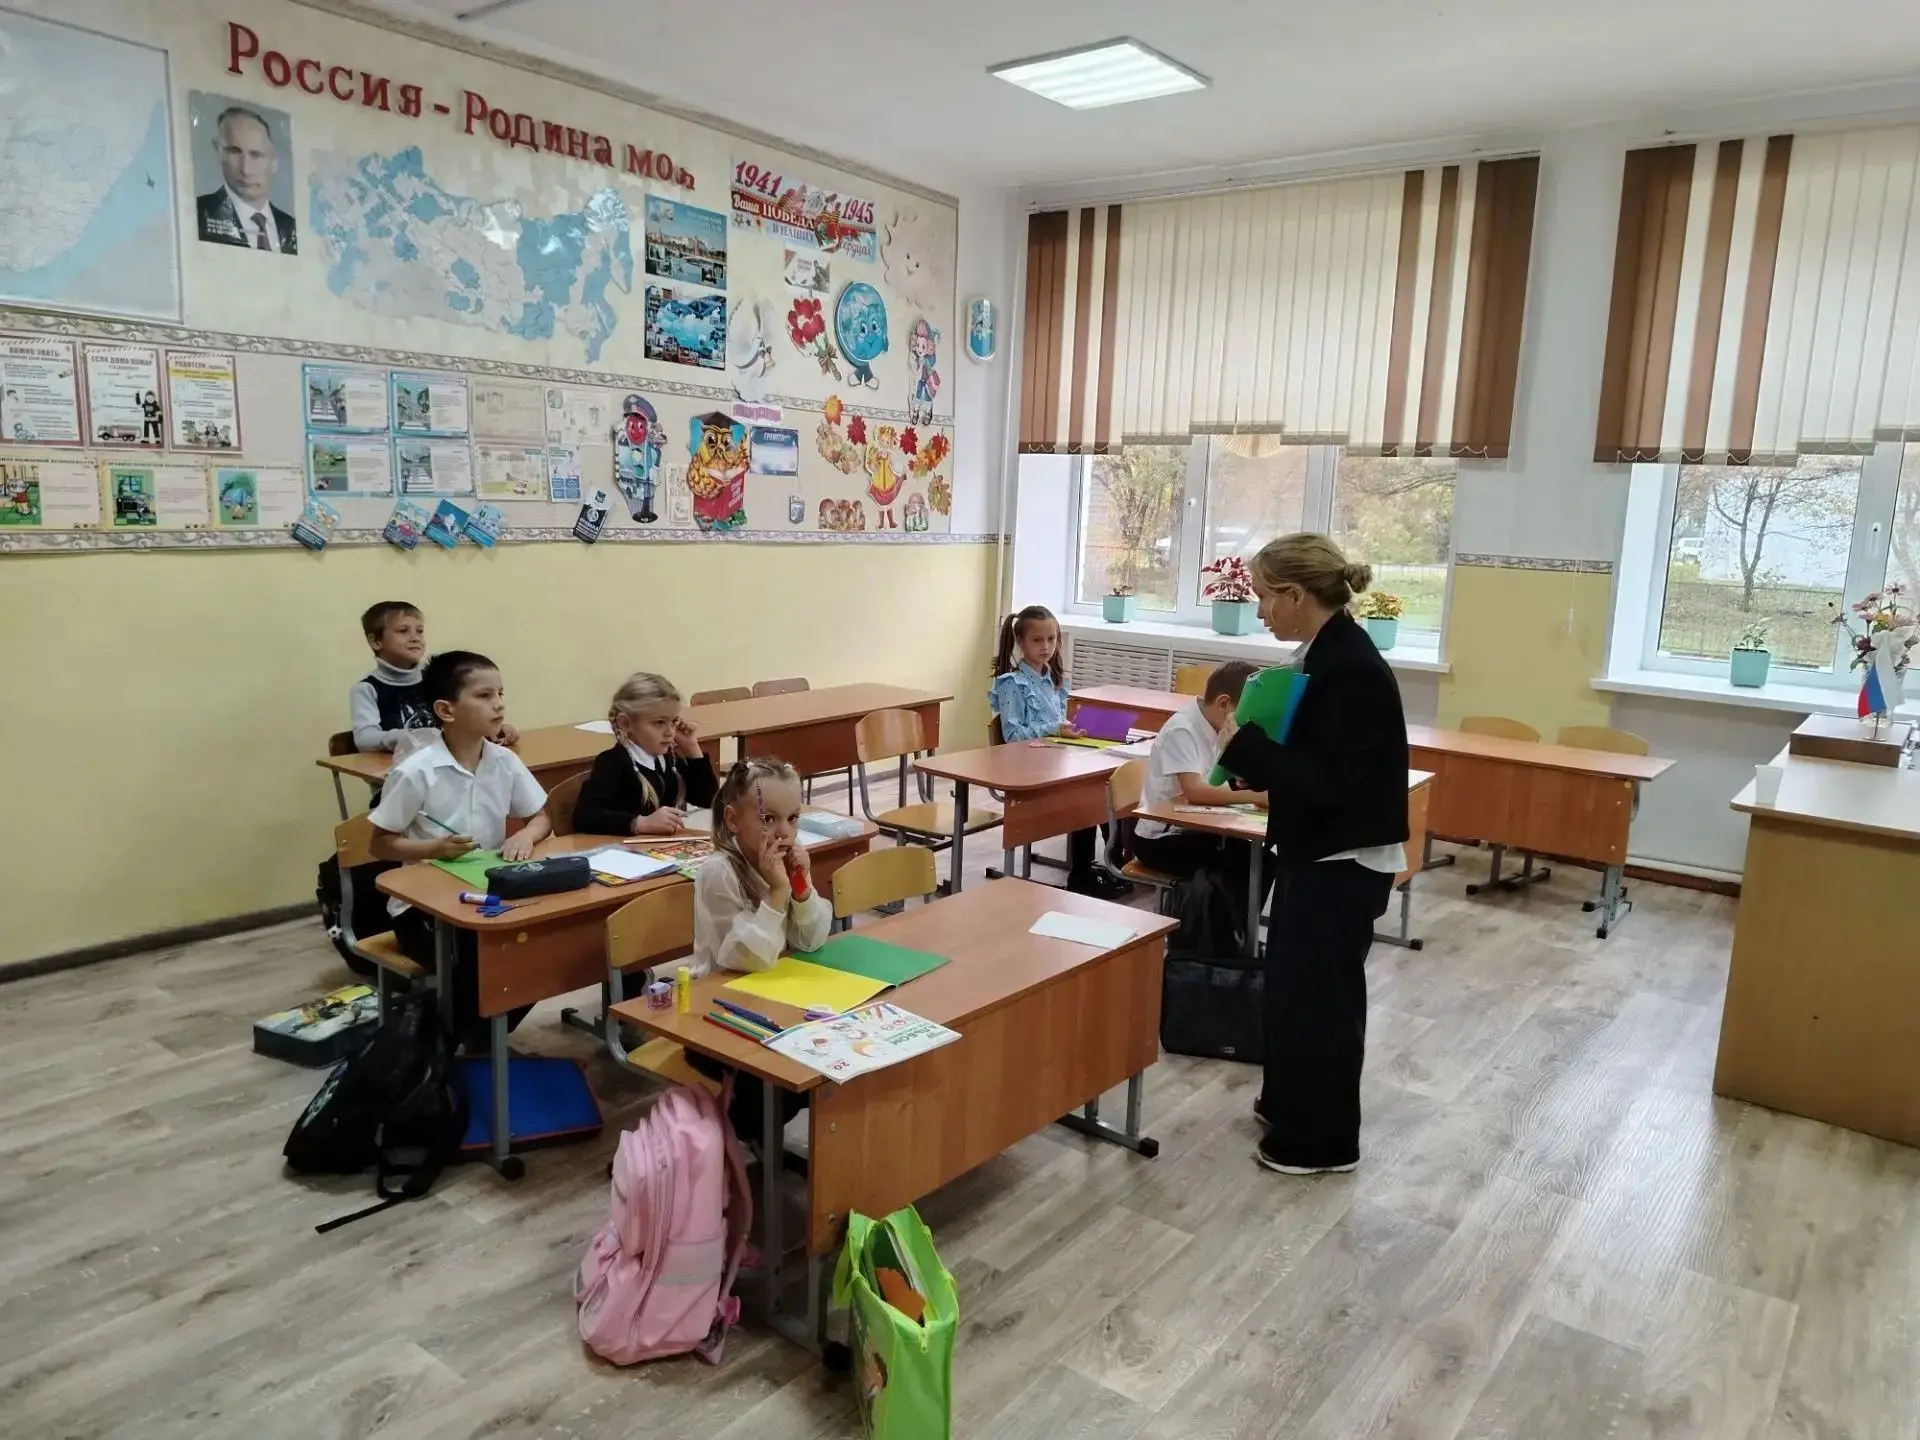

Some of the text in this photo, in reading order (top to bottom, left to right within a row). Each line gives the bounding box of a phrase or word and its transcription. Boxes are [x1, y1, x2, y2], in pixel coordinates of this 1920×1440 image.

[228, 21, 423, 119] Россия
[463, 89, 615, 168] Родина
[735, 160, 783, 199] 1941
[841, 197, 875, 226] 1945
